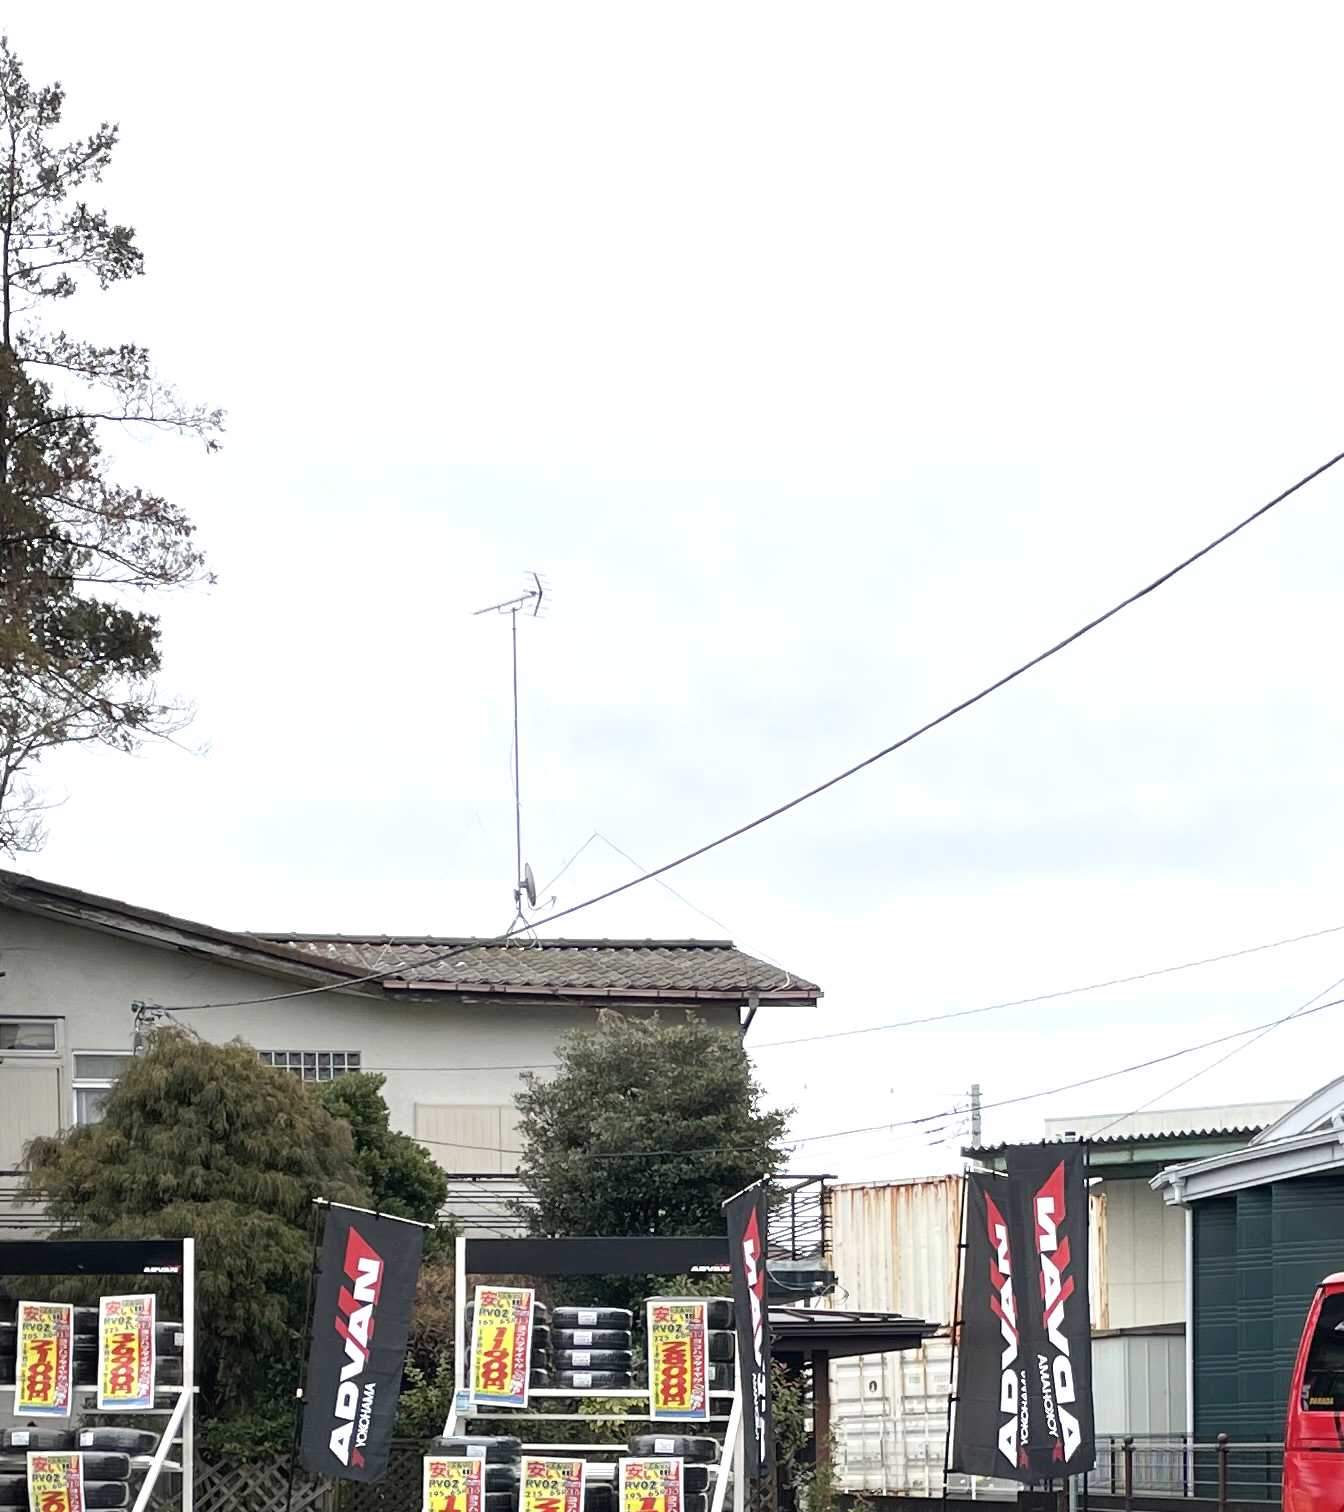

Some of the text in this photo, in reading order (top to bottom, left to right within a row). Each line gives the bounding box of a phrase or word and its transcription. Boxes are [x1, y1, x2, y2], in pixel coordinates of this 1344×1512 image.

[328, 1257, 383, 1467] ADVAN
[996, 1222, 1019, 1469] ADVAN
[355, 1382, 376, 1449] YOKOHAMA
[525, 1479, 558, 1489] RV02
